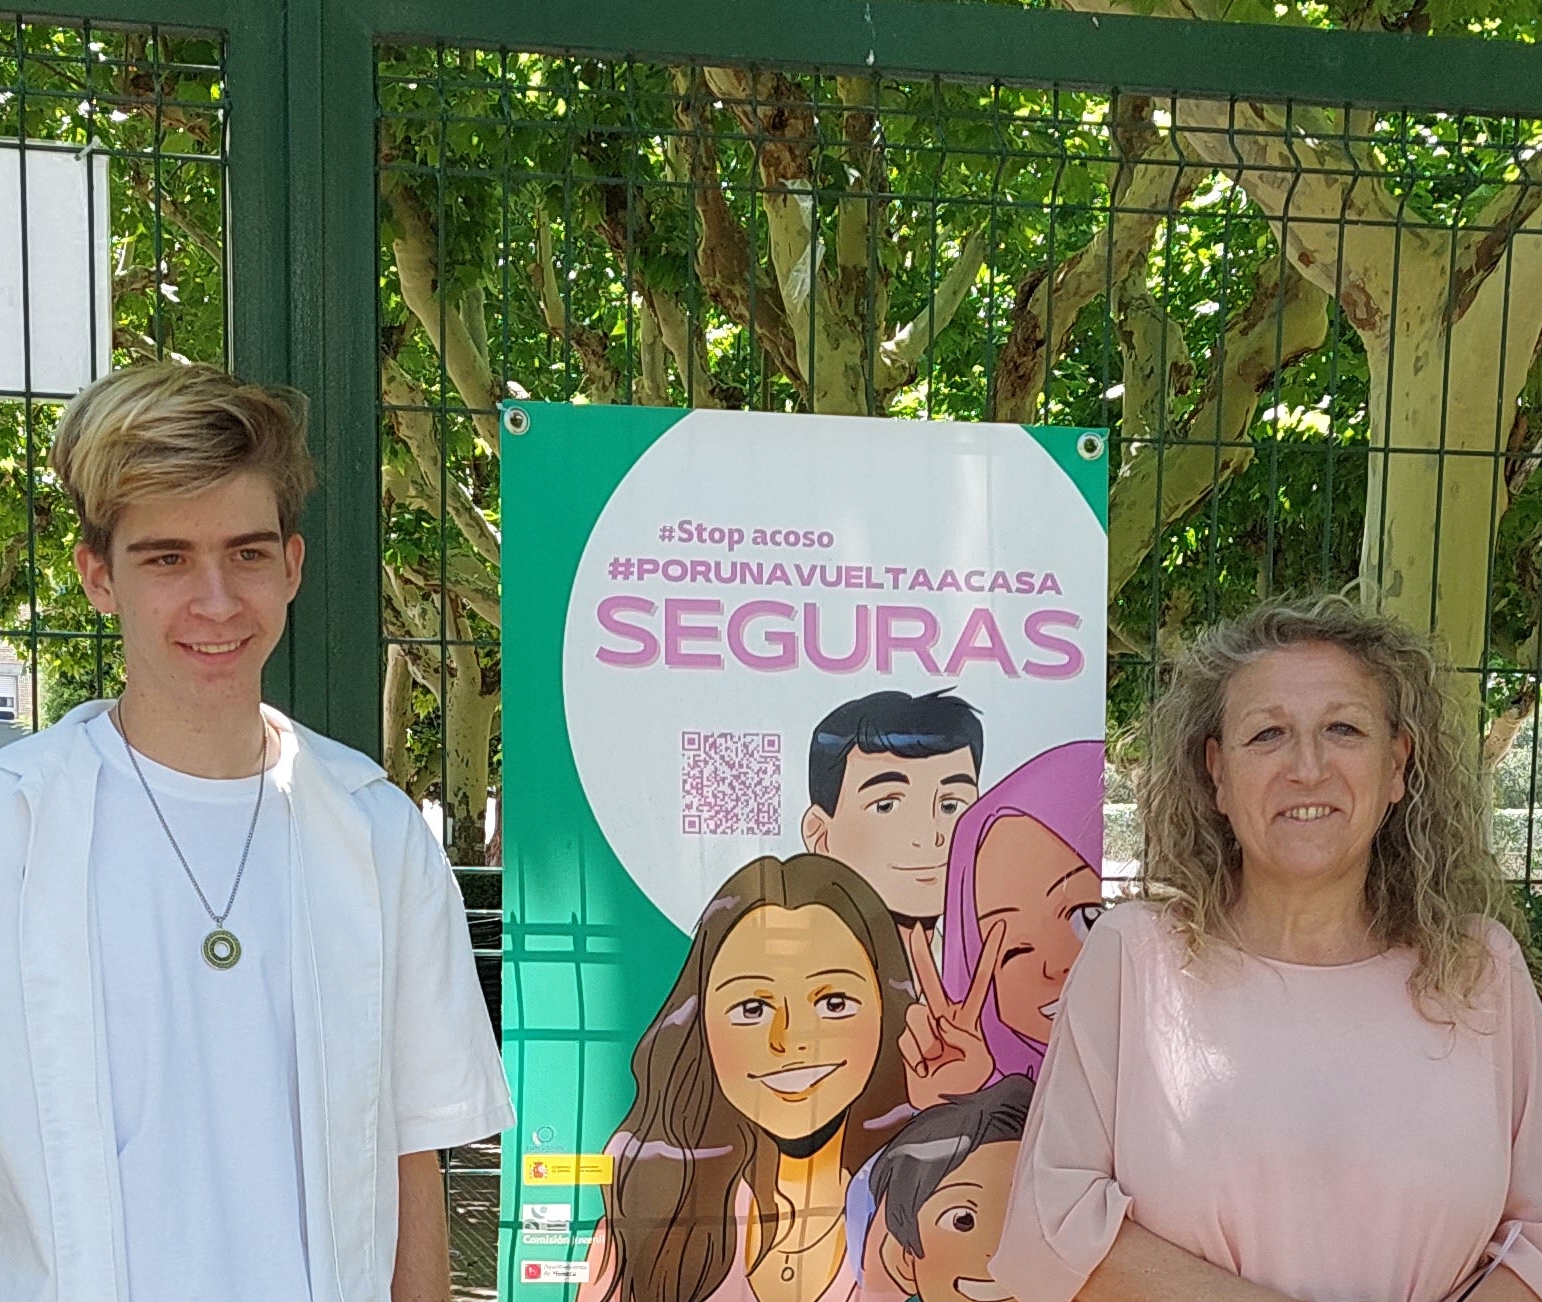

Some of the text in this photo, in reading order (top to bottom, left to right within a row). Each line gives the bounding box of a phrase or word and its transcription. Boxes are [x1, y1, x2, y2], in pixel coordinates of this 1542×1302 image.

[658, 519, 835, 552] #Stop acoso
[607, 556, 1063, 596] #PORUNAVUELTAACASA
[594, 595, 1085, 680] SEGURAS
